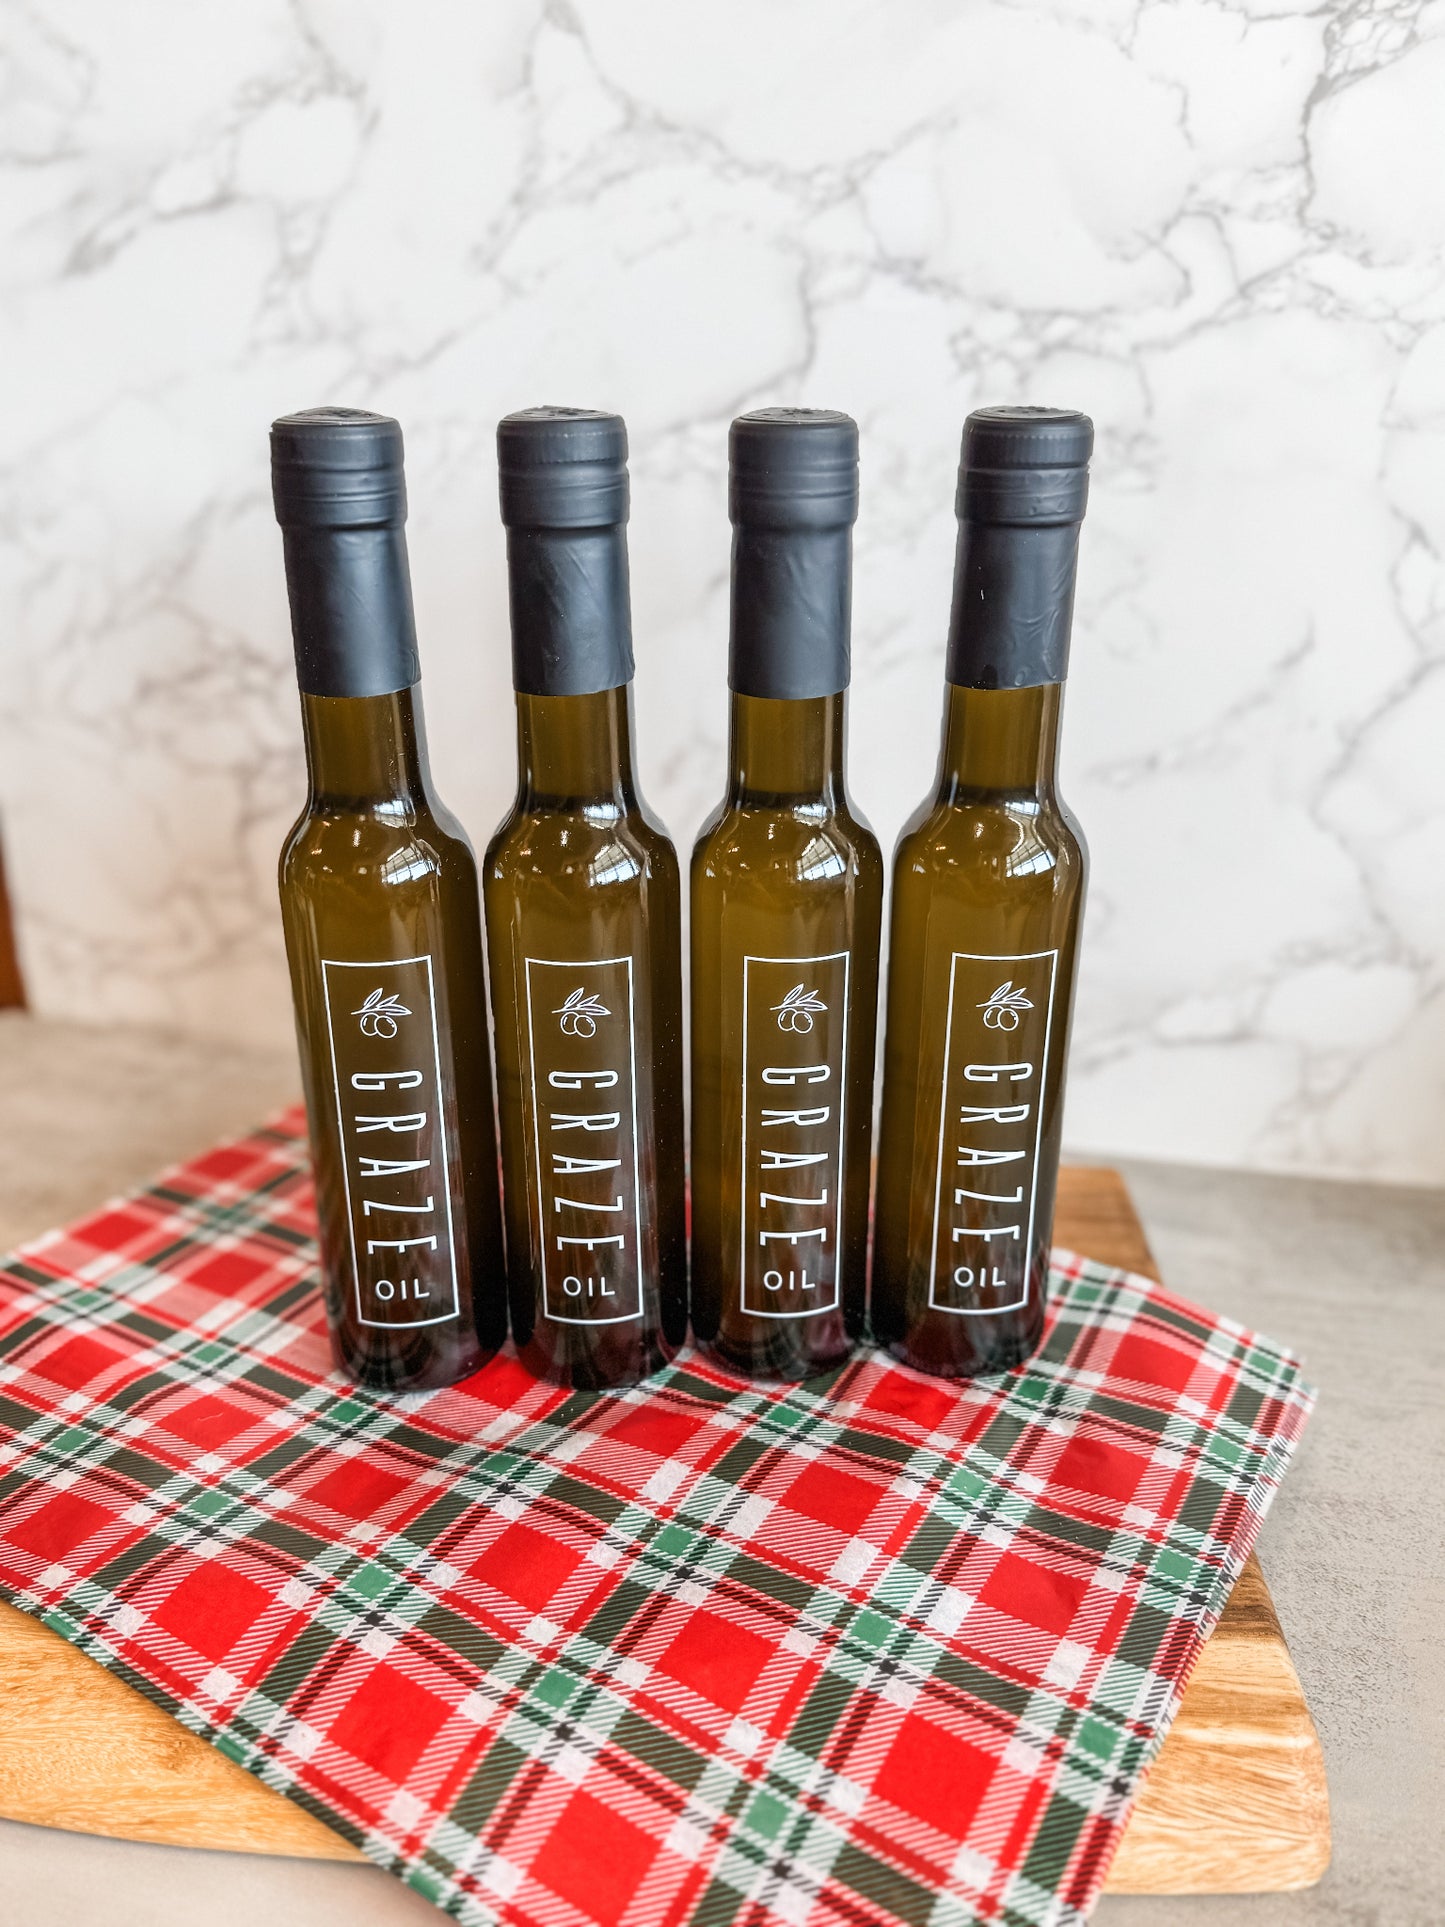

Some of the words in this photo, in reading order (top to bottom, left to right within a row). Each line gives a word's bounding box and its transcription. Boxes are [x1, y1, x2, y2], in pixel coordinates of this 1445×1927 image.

[351, 1070, 438, 1255] GRAZE
[548, 1070, 625, 1251] GRAZE
[759, 1064, 831, 1246] GRAZE
[952, 1062, 1034, 1242] GRAZE
[375, 1278, 430, 1301] OIL
[563, 1276, 616, 1297] OIL
[763, 1269, 816, 1291] OIL
[953, 1266, 1007, 1287] OIL
